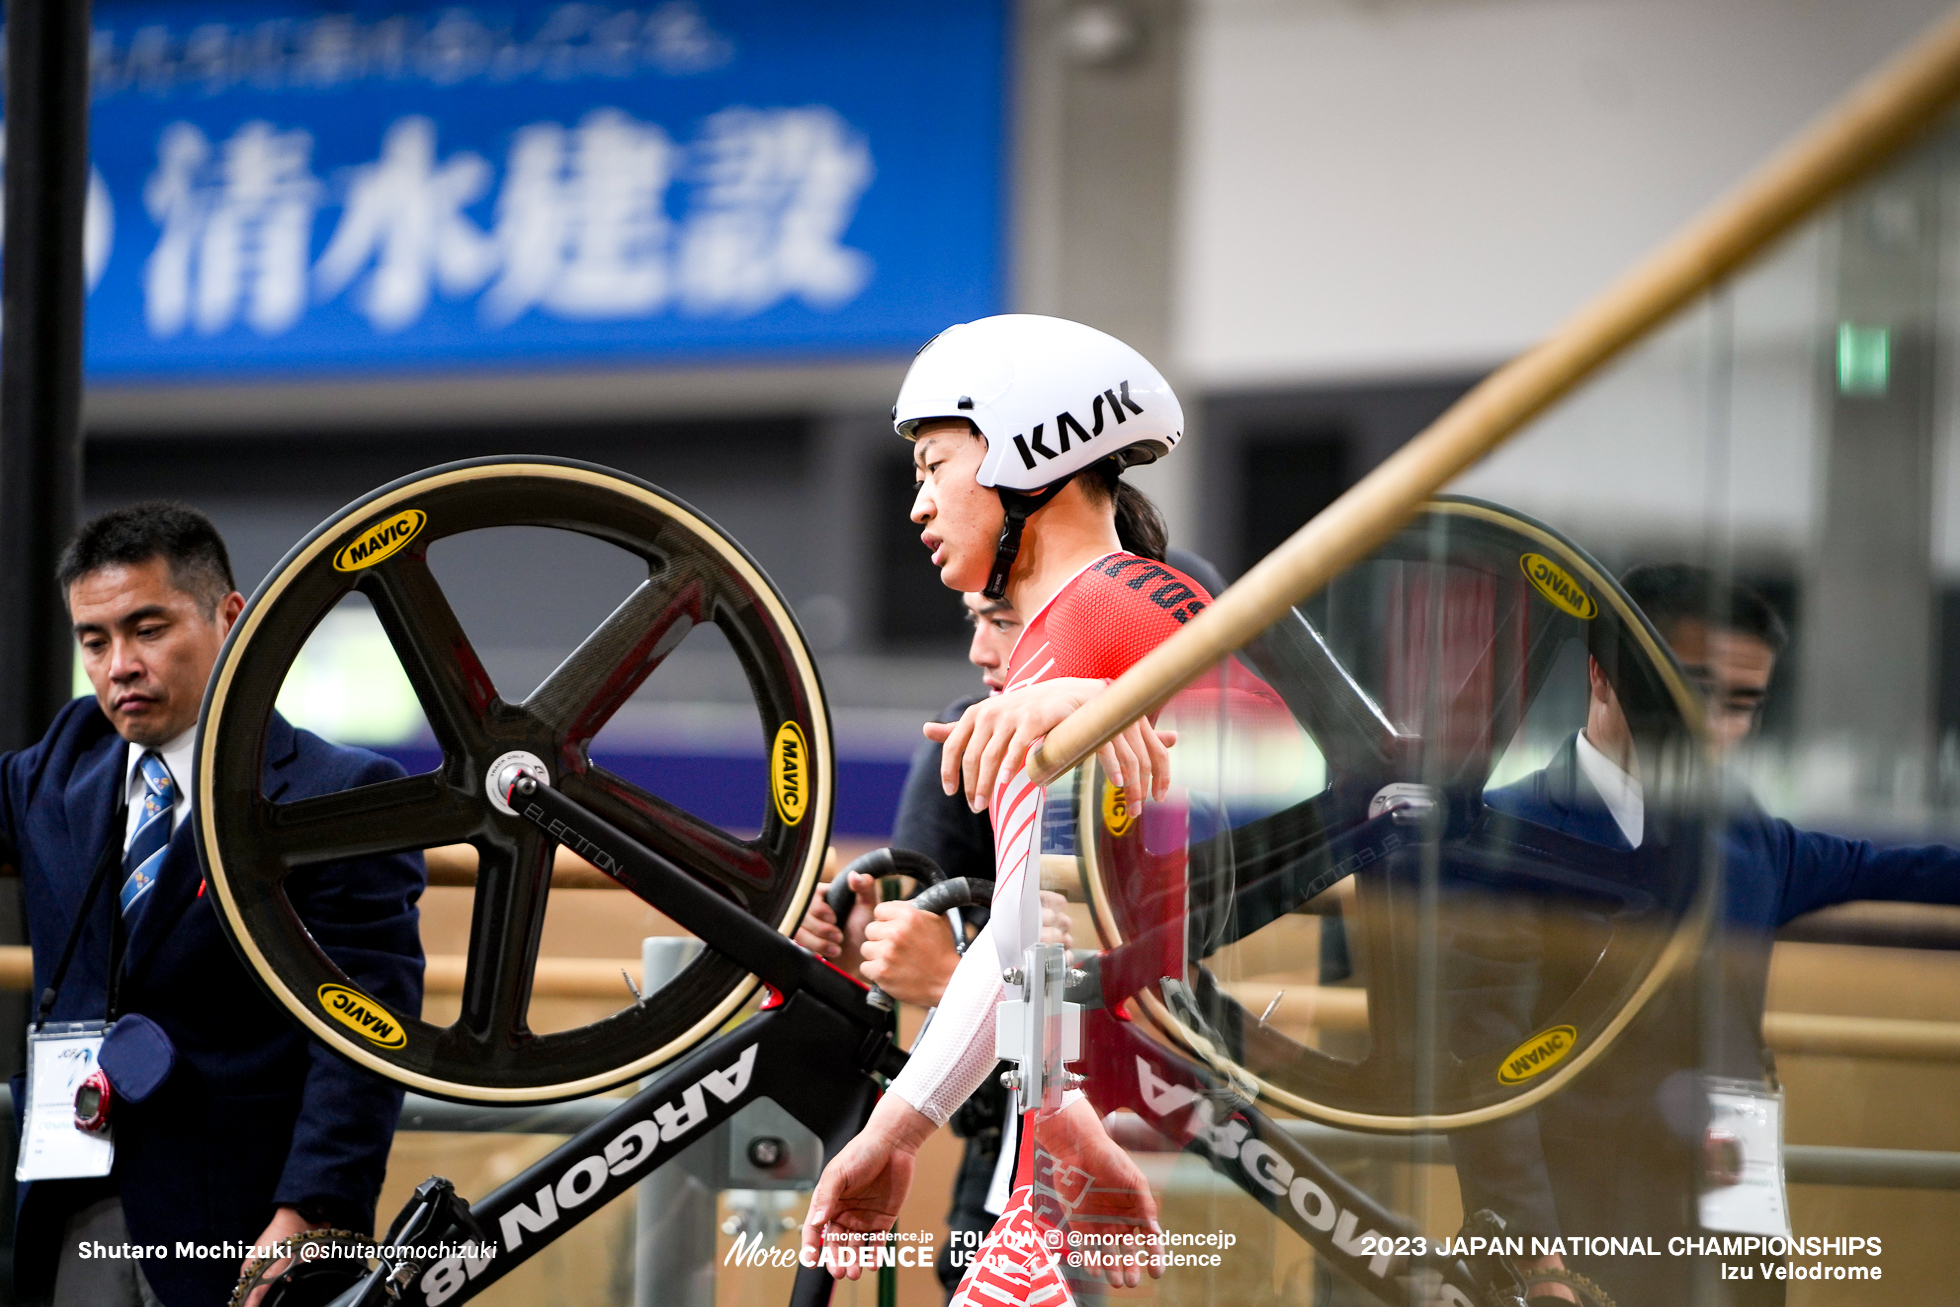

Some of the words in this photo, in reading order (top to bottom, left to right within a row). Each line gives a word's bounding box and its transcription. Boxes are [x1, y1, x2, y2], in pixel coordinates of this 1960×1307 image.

[143, 105, 876, 339] 清水建設
[1012, 380, 1144, 470] KASK
[350, 519, 411, 564] MAVIC
[782, 739, 799, 806] MAVIC
[333, 994, 394, 1039] MAVIC
[499, 1042, 758, 1252] ARGON
